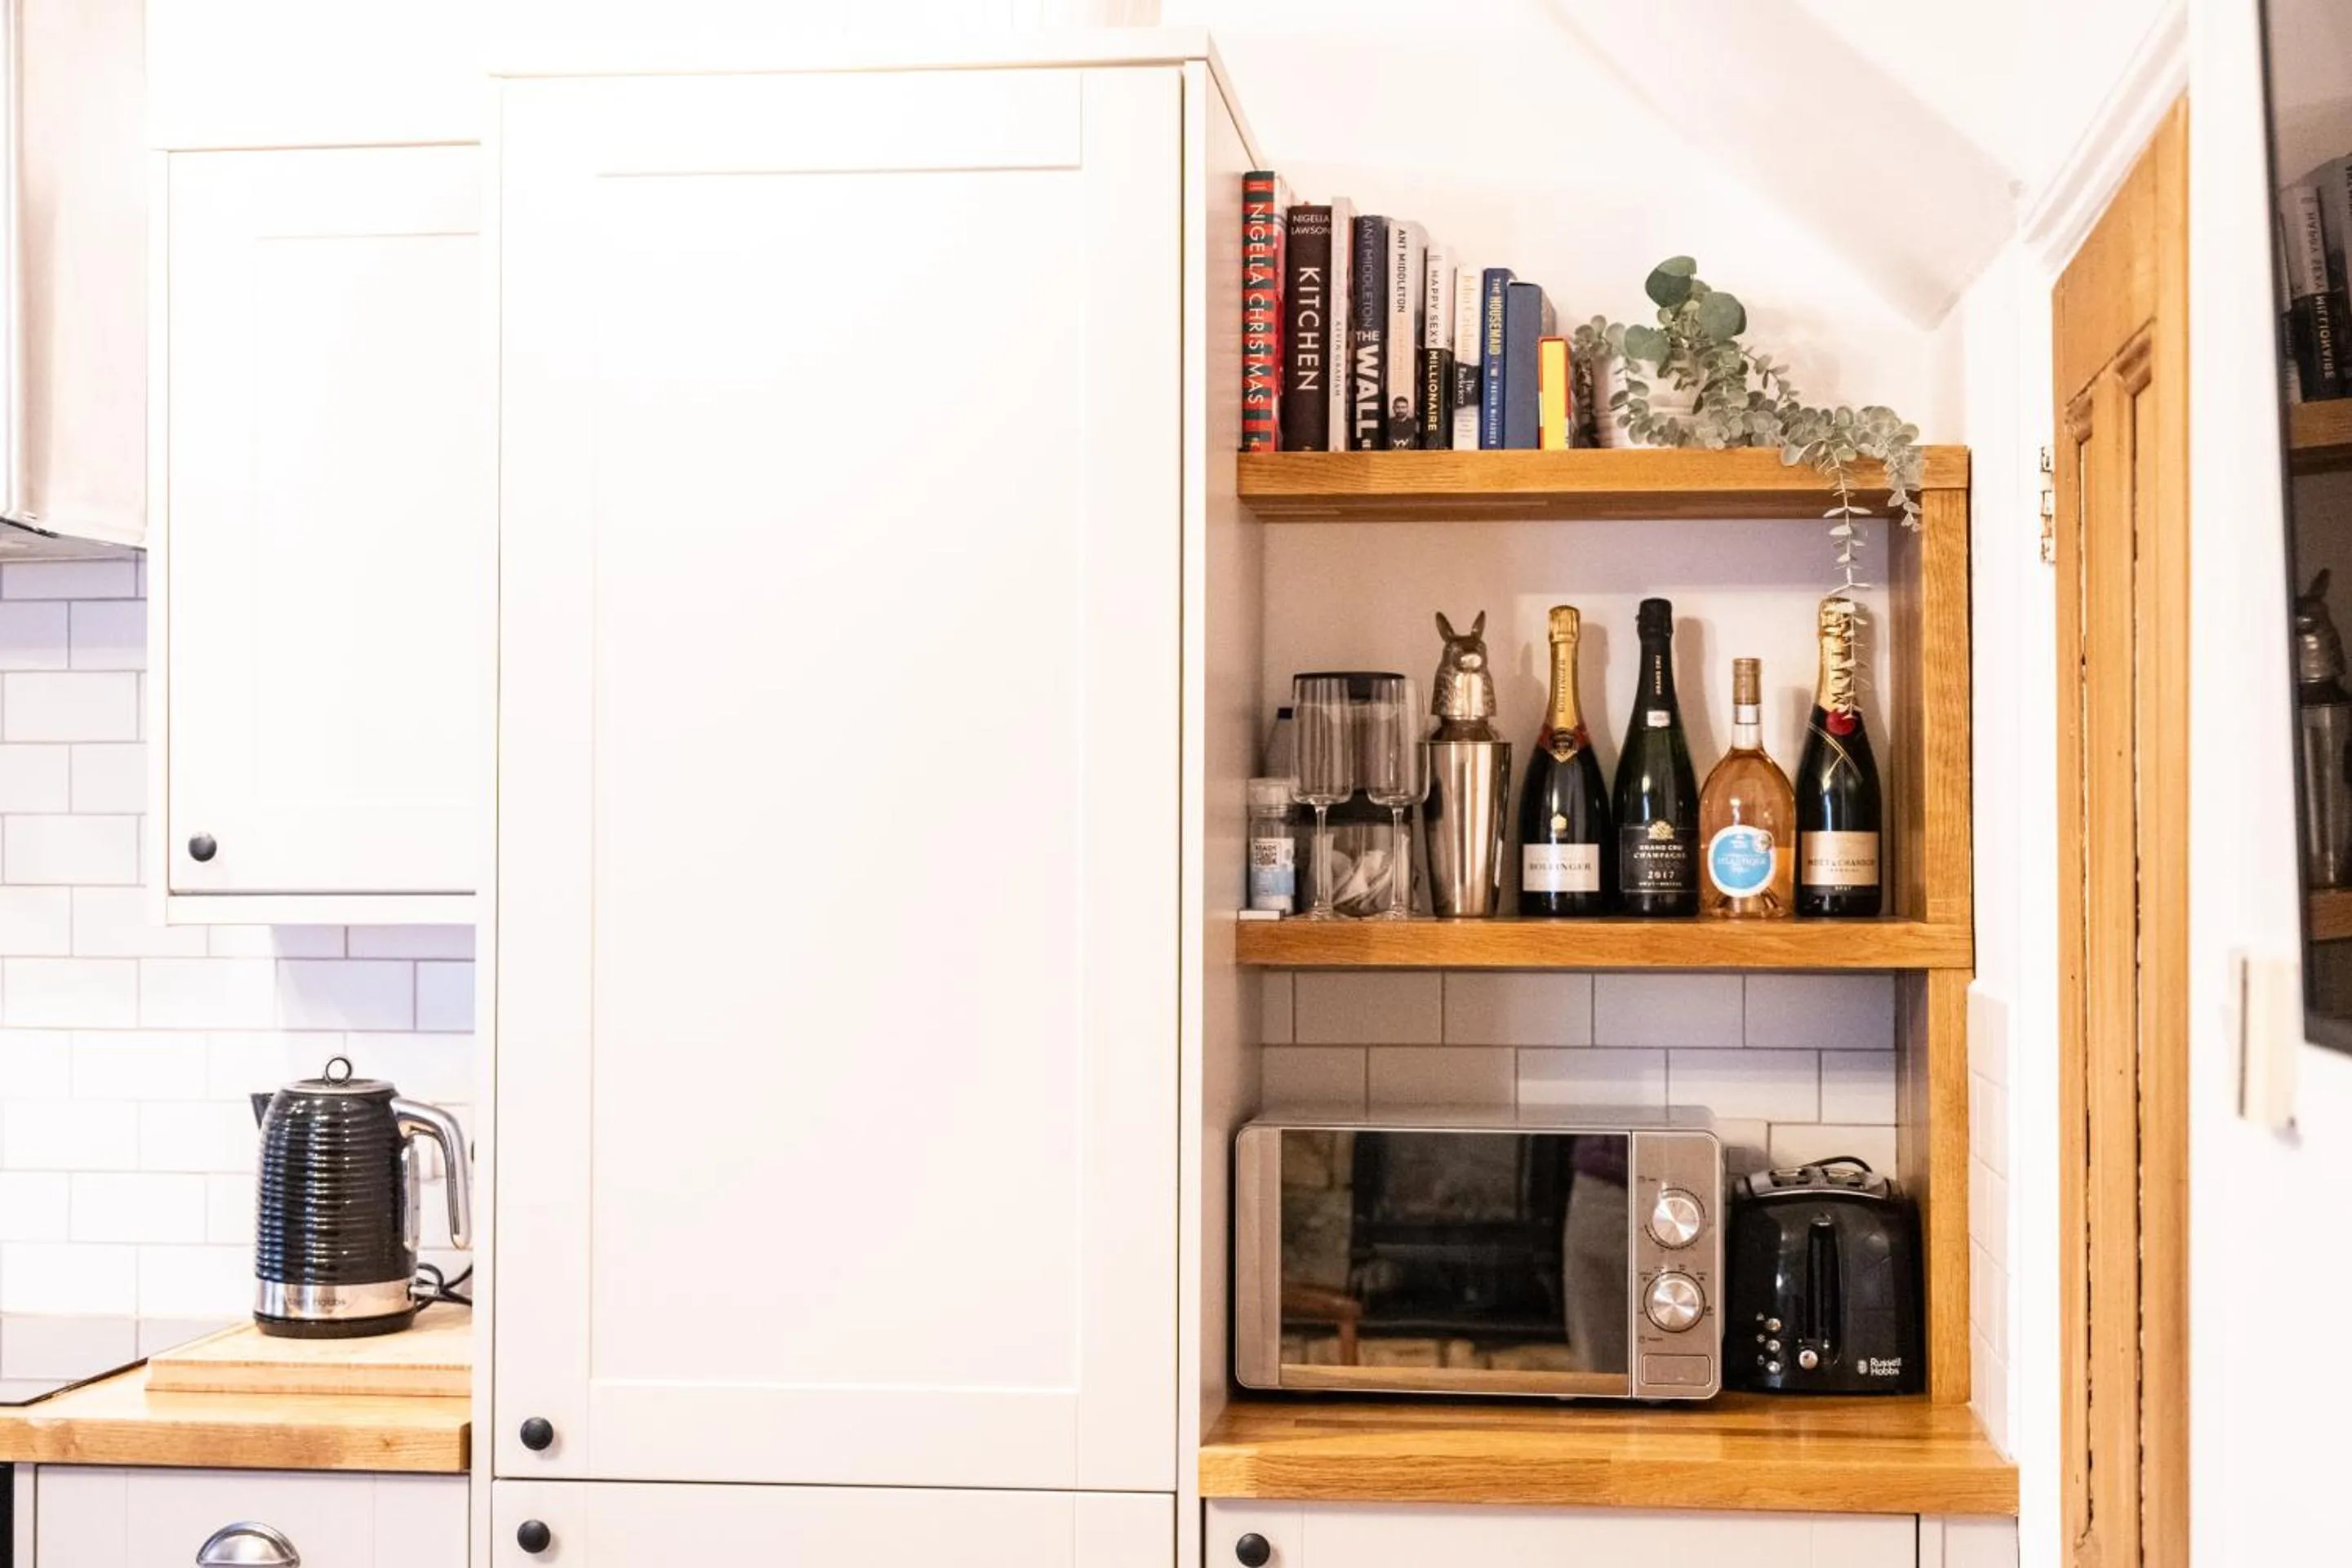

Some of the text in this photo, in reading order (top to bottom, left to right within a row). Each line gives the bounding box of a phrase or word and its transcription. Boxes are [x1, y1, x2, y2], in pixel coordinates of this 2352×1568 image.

[1291, 225, 1331, 236] LAWSON
[1292, 214, 1330, 224] NIGELLA
[1397, 229, 1406, 249] ANT
[1362, 220, 1375, 328] ANT MIDDLETON
[1397, 253, 1407, 313] MIDDLETON
[1247, 203, 1265, 405] NIGELLA CHRISTMAS
[1296, 266, 1320, 391] KITCHEN
[1356, 330, 1381, 342] THE
[1487, 295, 1503, 356] HOUSEMAID
[1427, 269, 1439, 432] HAPPY SEXY MILLIONAIRE
[1355, 344, 1380, 440] WALL
[1647, 870, 1675, 879] 2017
[1870, 1357, 1903, 1366] Russell
[1870, 1366, 1900, 1376] Hobbs
